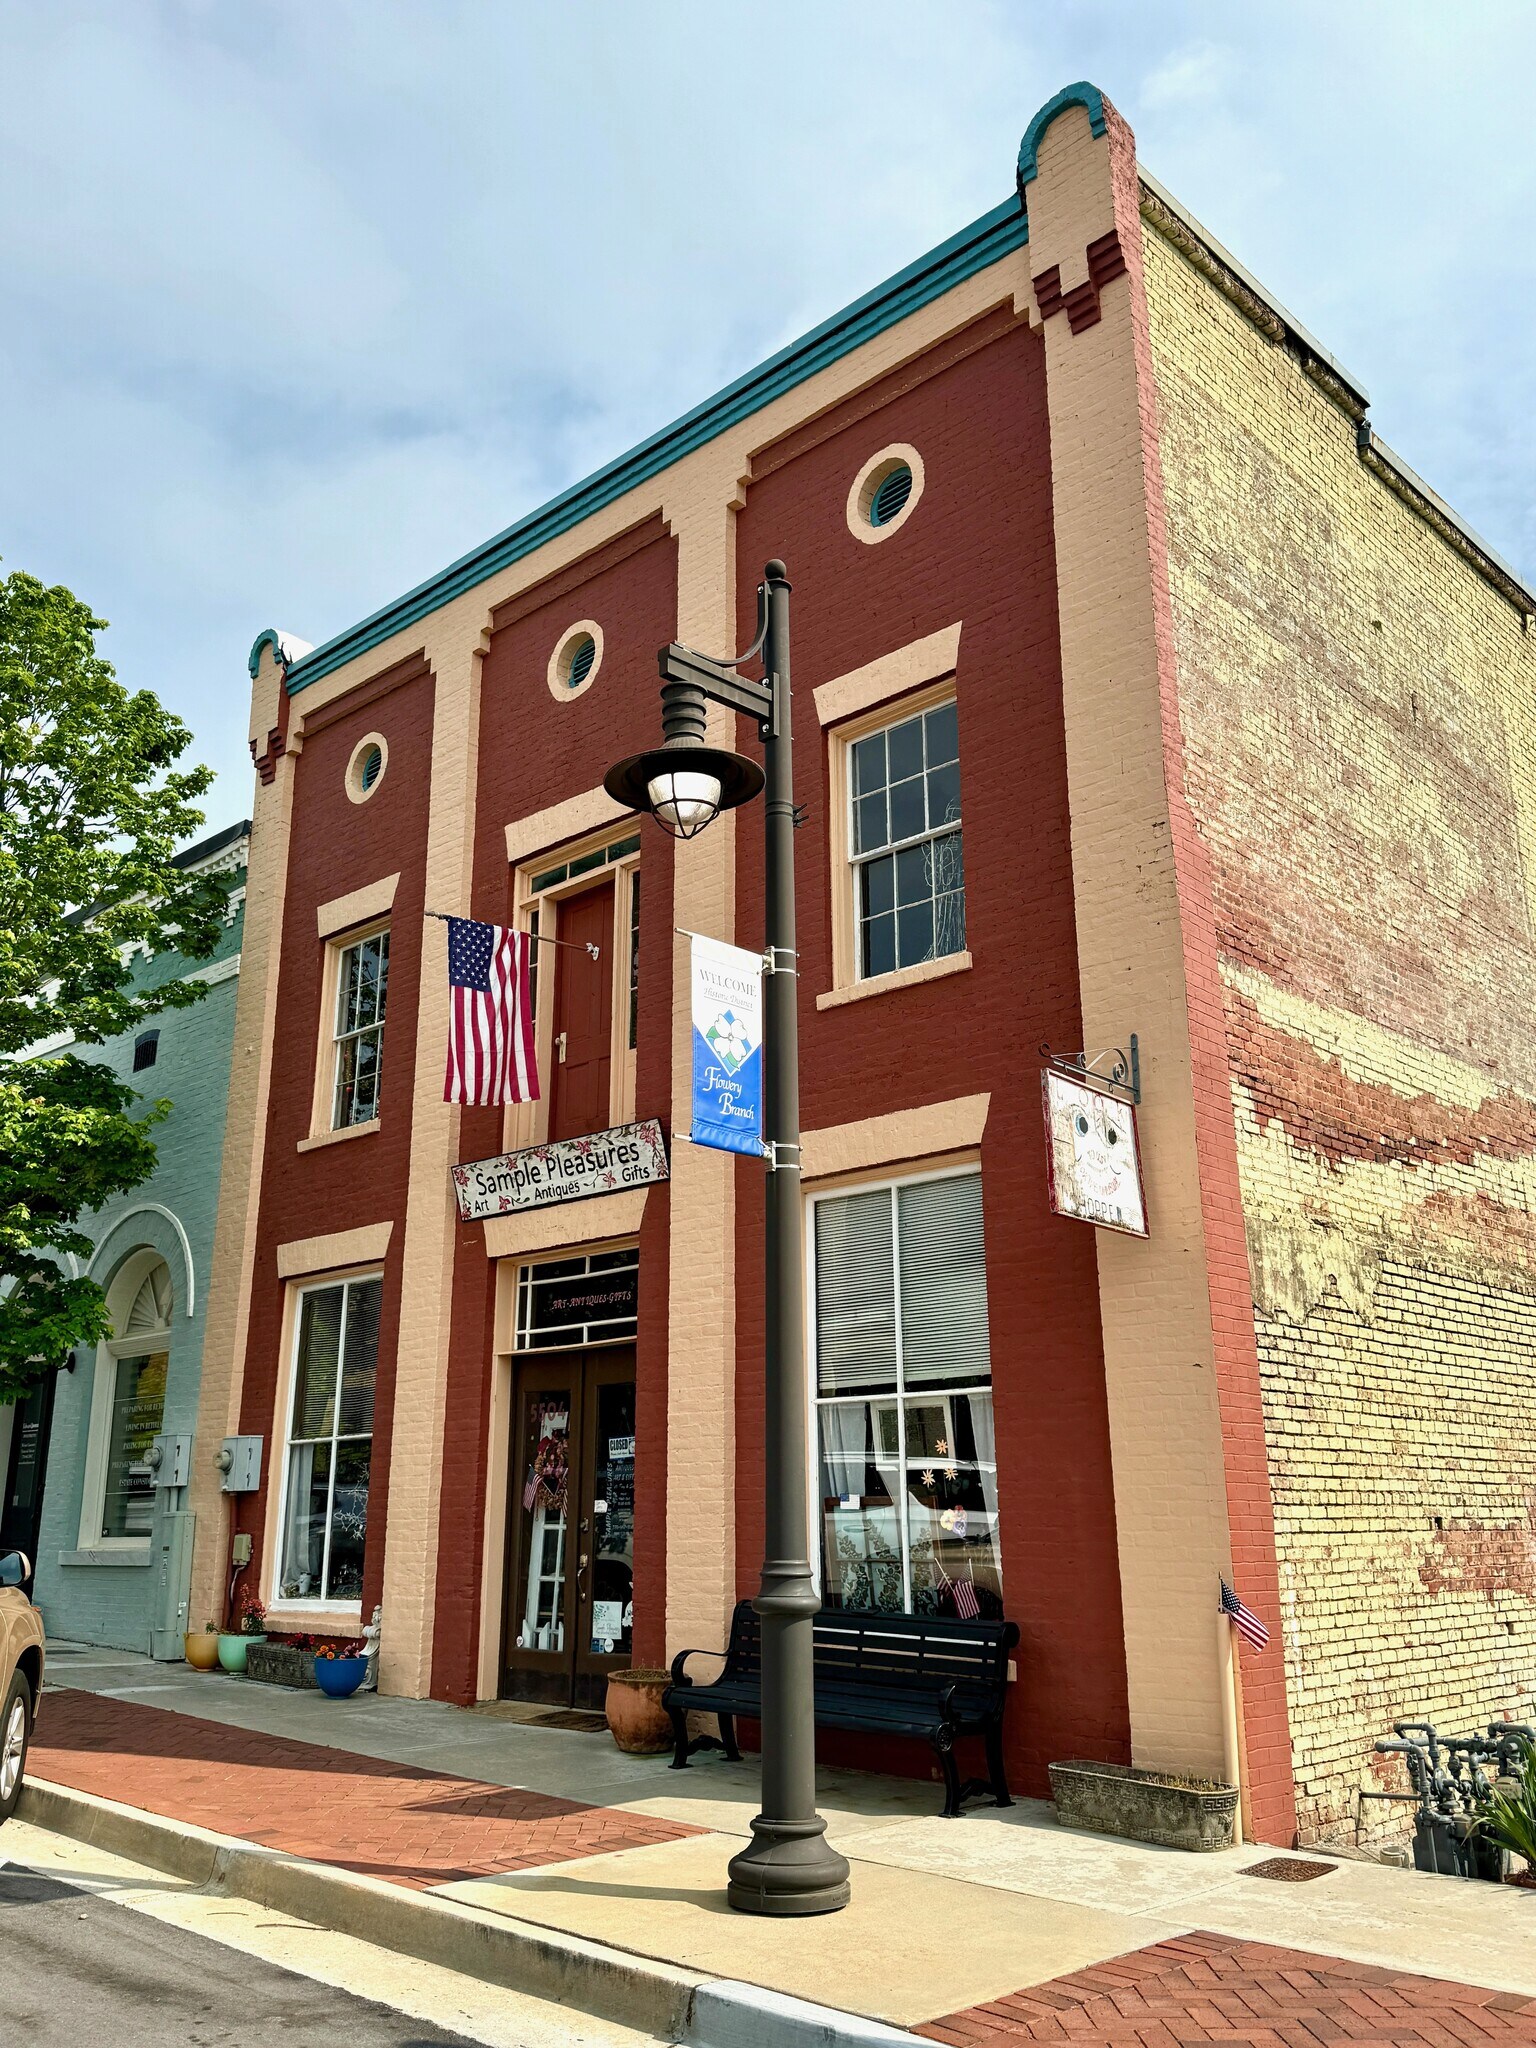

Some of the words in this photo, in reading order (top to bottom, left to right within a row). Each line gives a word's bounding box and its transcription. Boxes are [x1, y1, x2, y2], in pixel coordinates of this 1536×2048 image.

[700, 969, 757, 997] WELCOME
[703, 987, 729, 1001] Historic
[702, 1066, 742, 1099] Flowery
[719, 1092, 755, 1120] Branch
[476, 1162, 542, 1197] Sample
[546, 1141, 640, 1181] Pleasures
[474, 1199, 490, 1213] Art
[534, 1181, 581, 1201] Antiques
[621, 1163, 651, 1183] Gifts
[530, 1401, 566, 1423] 5504
[610, 1438, 629, 1451] CLOSED
